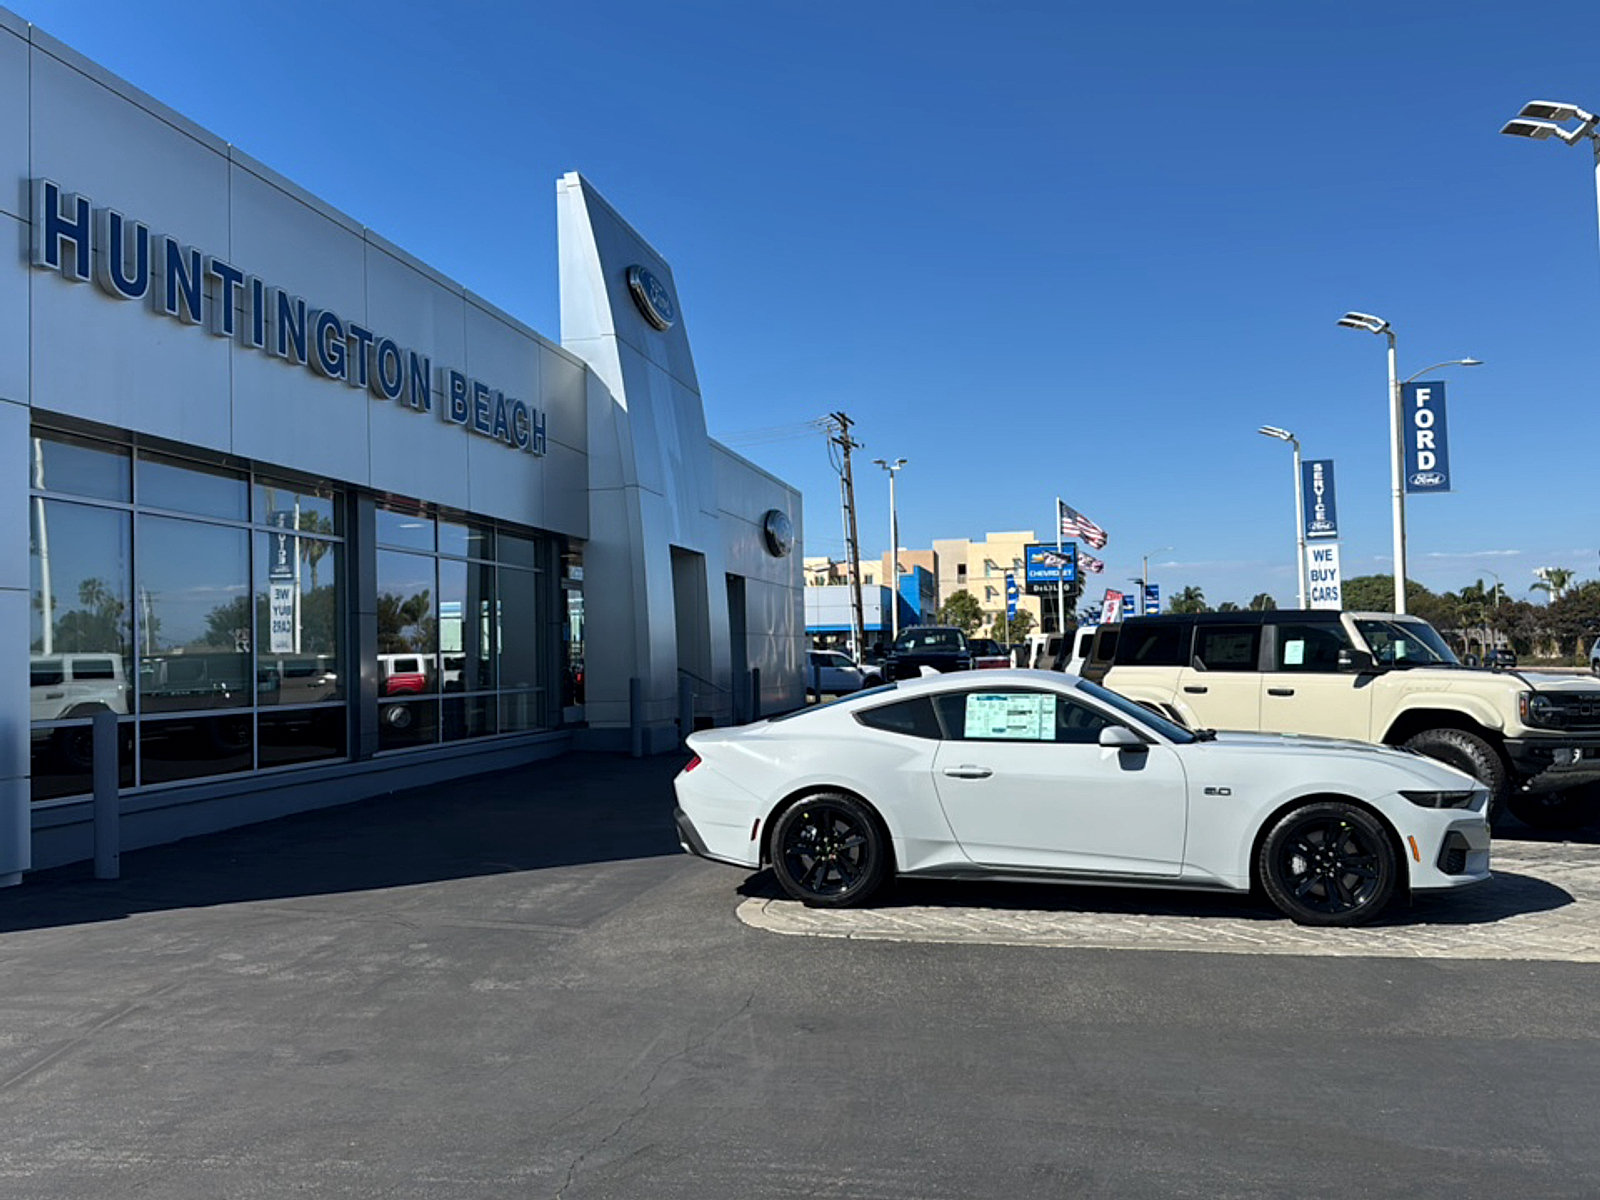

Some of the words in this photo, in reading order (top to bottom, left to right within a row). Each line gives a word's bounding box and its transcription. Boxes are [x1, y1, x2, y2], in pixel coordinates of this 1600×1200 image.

[33, 178, 432, 413] HUNTINGTON
[442, 366, 548, 457] BEACH
[1414, 388, 1437, 470] FORD
[1412, 473, 1442, 486] Ford
[1313, 463, 1326, 521] SERVICE
[1313, 549, 1333, 562] WE
[1029, 569, 1072, 577] CHEVROET
[1310, 569, 1337, 582] BUY
[1311, 587, 1339, 602] CARS
